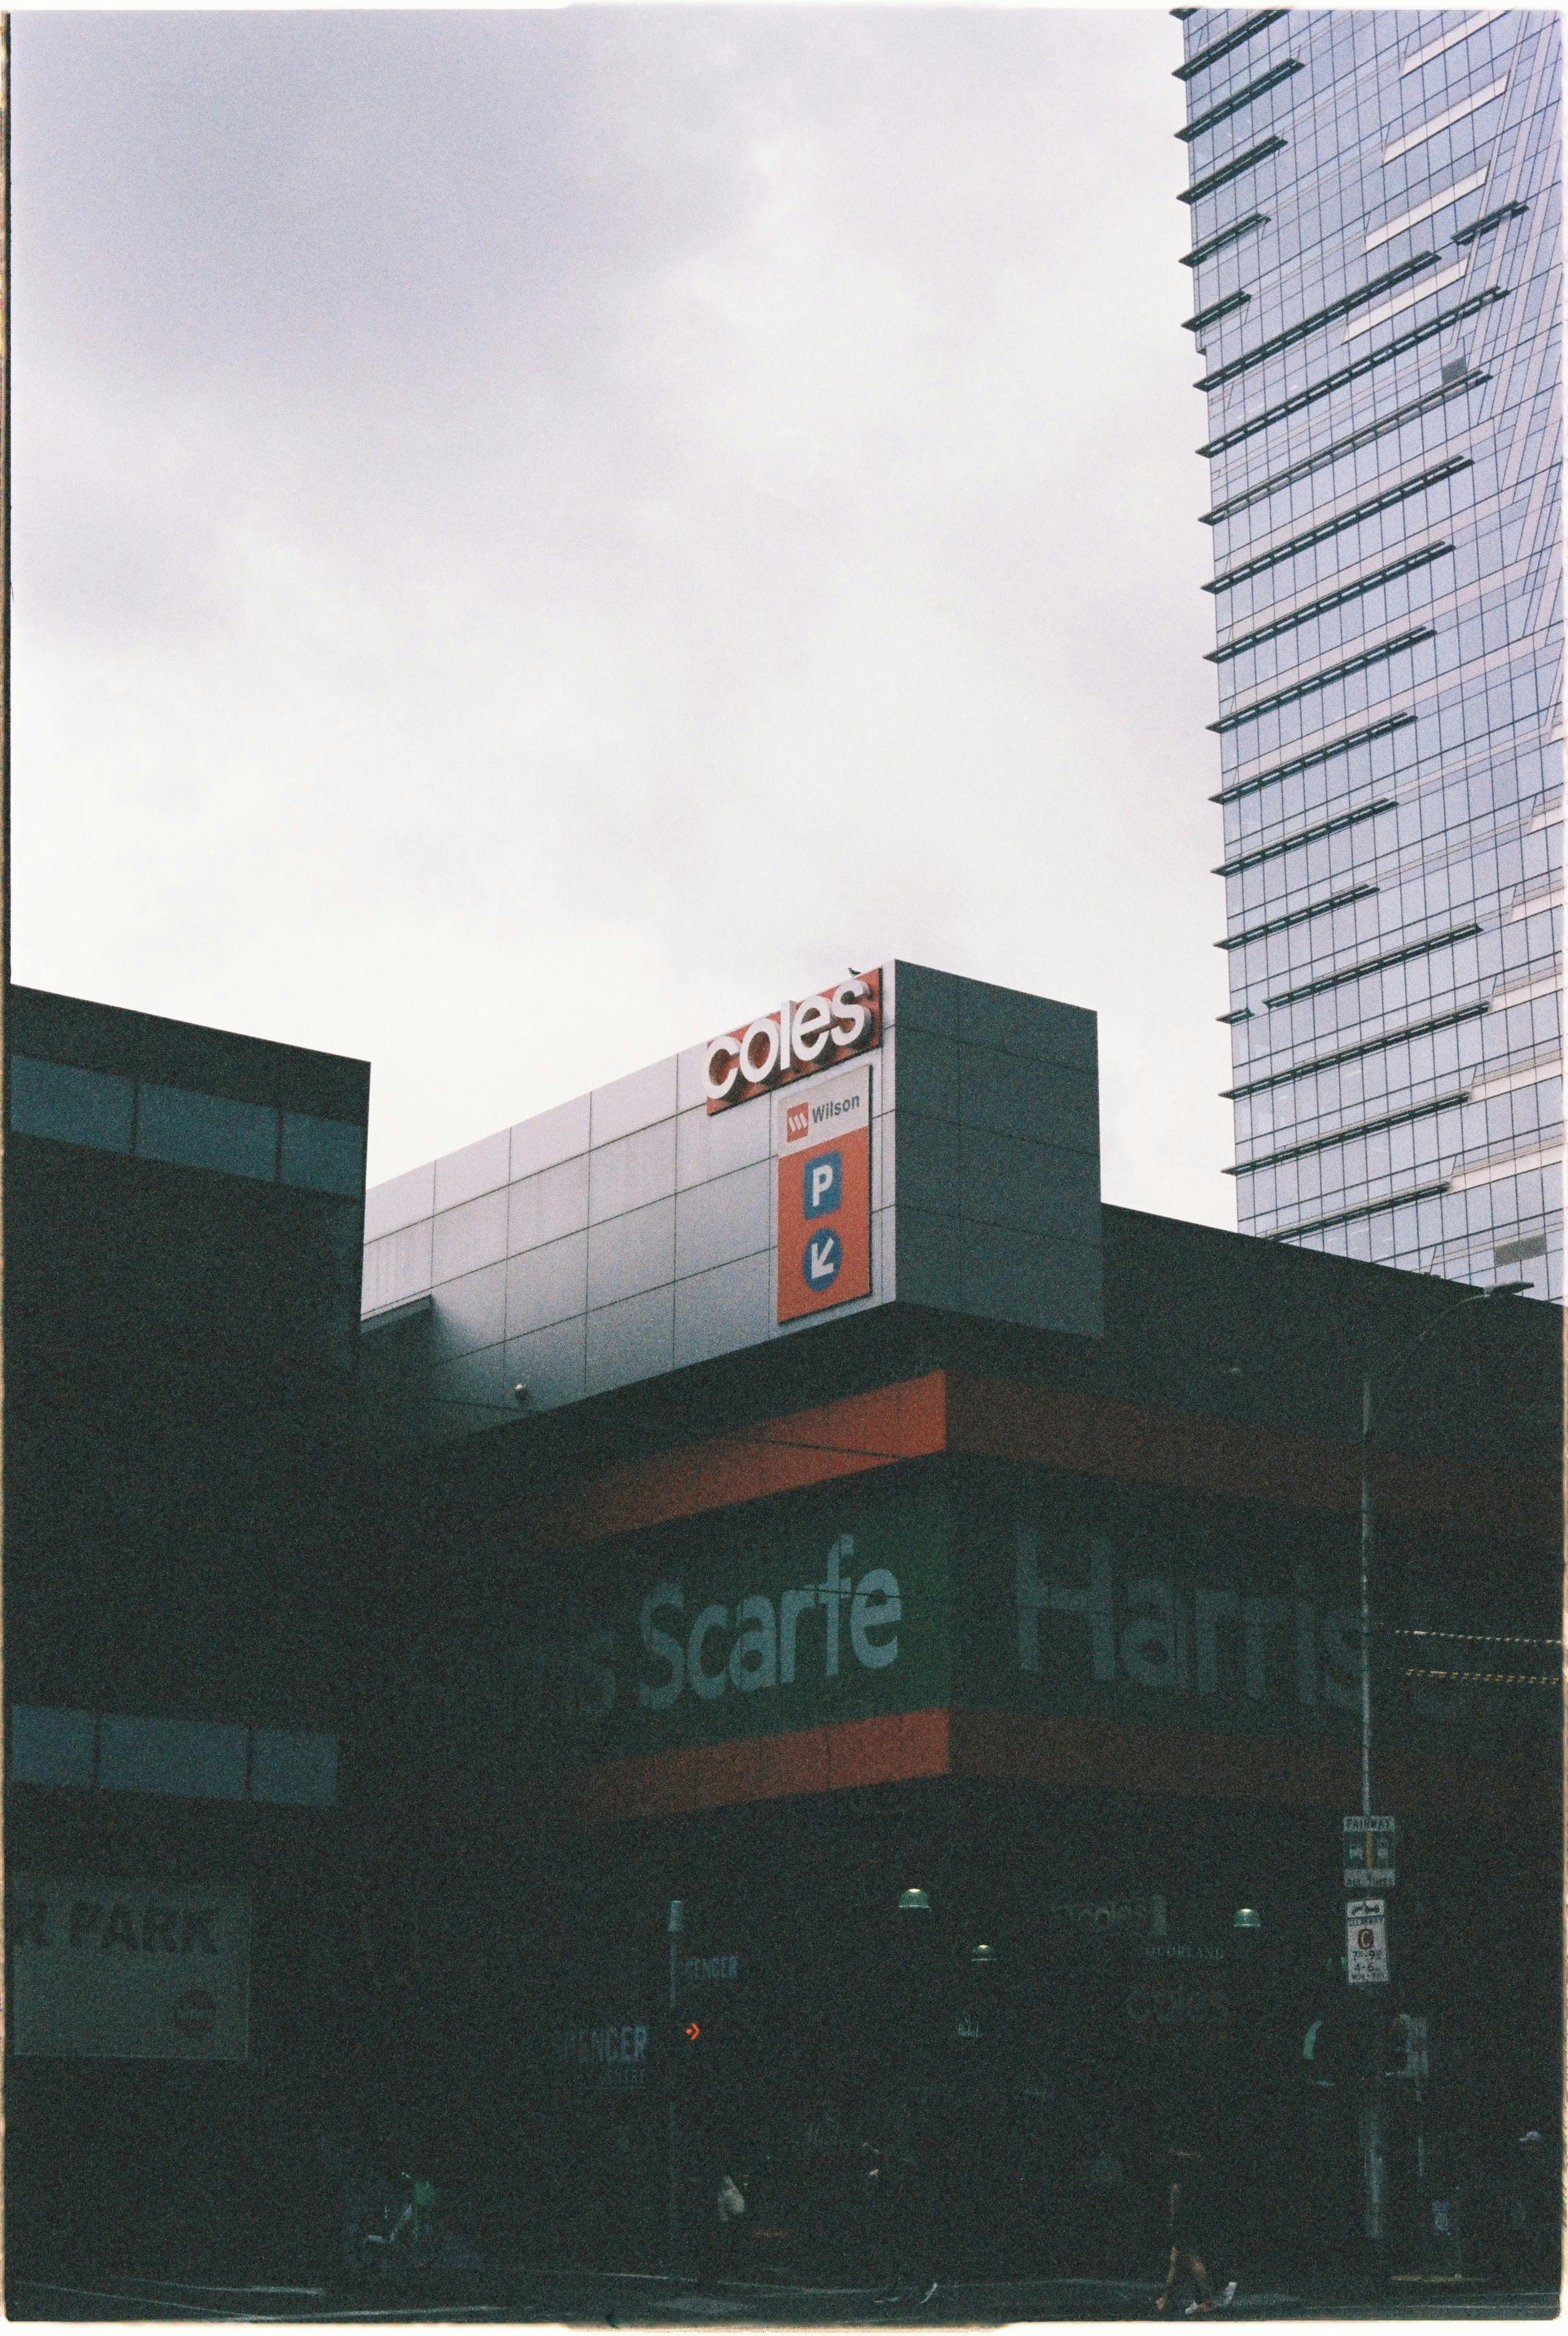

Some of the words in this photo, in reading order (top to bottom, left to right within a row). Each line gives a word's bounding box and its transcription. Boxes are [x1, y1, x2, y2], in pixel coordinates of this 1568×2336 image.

[702, 979, 872, 1100] coles
[812, 1093, 861, 1124] Wilson
[812, 1164, 834, 1207] P
[639, 1533, 903, 1710] Scarfe
[1015, 1520, 1372, 1714] Harris
[69, 1900, 220, 1954] PARK
